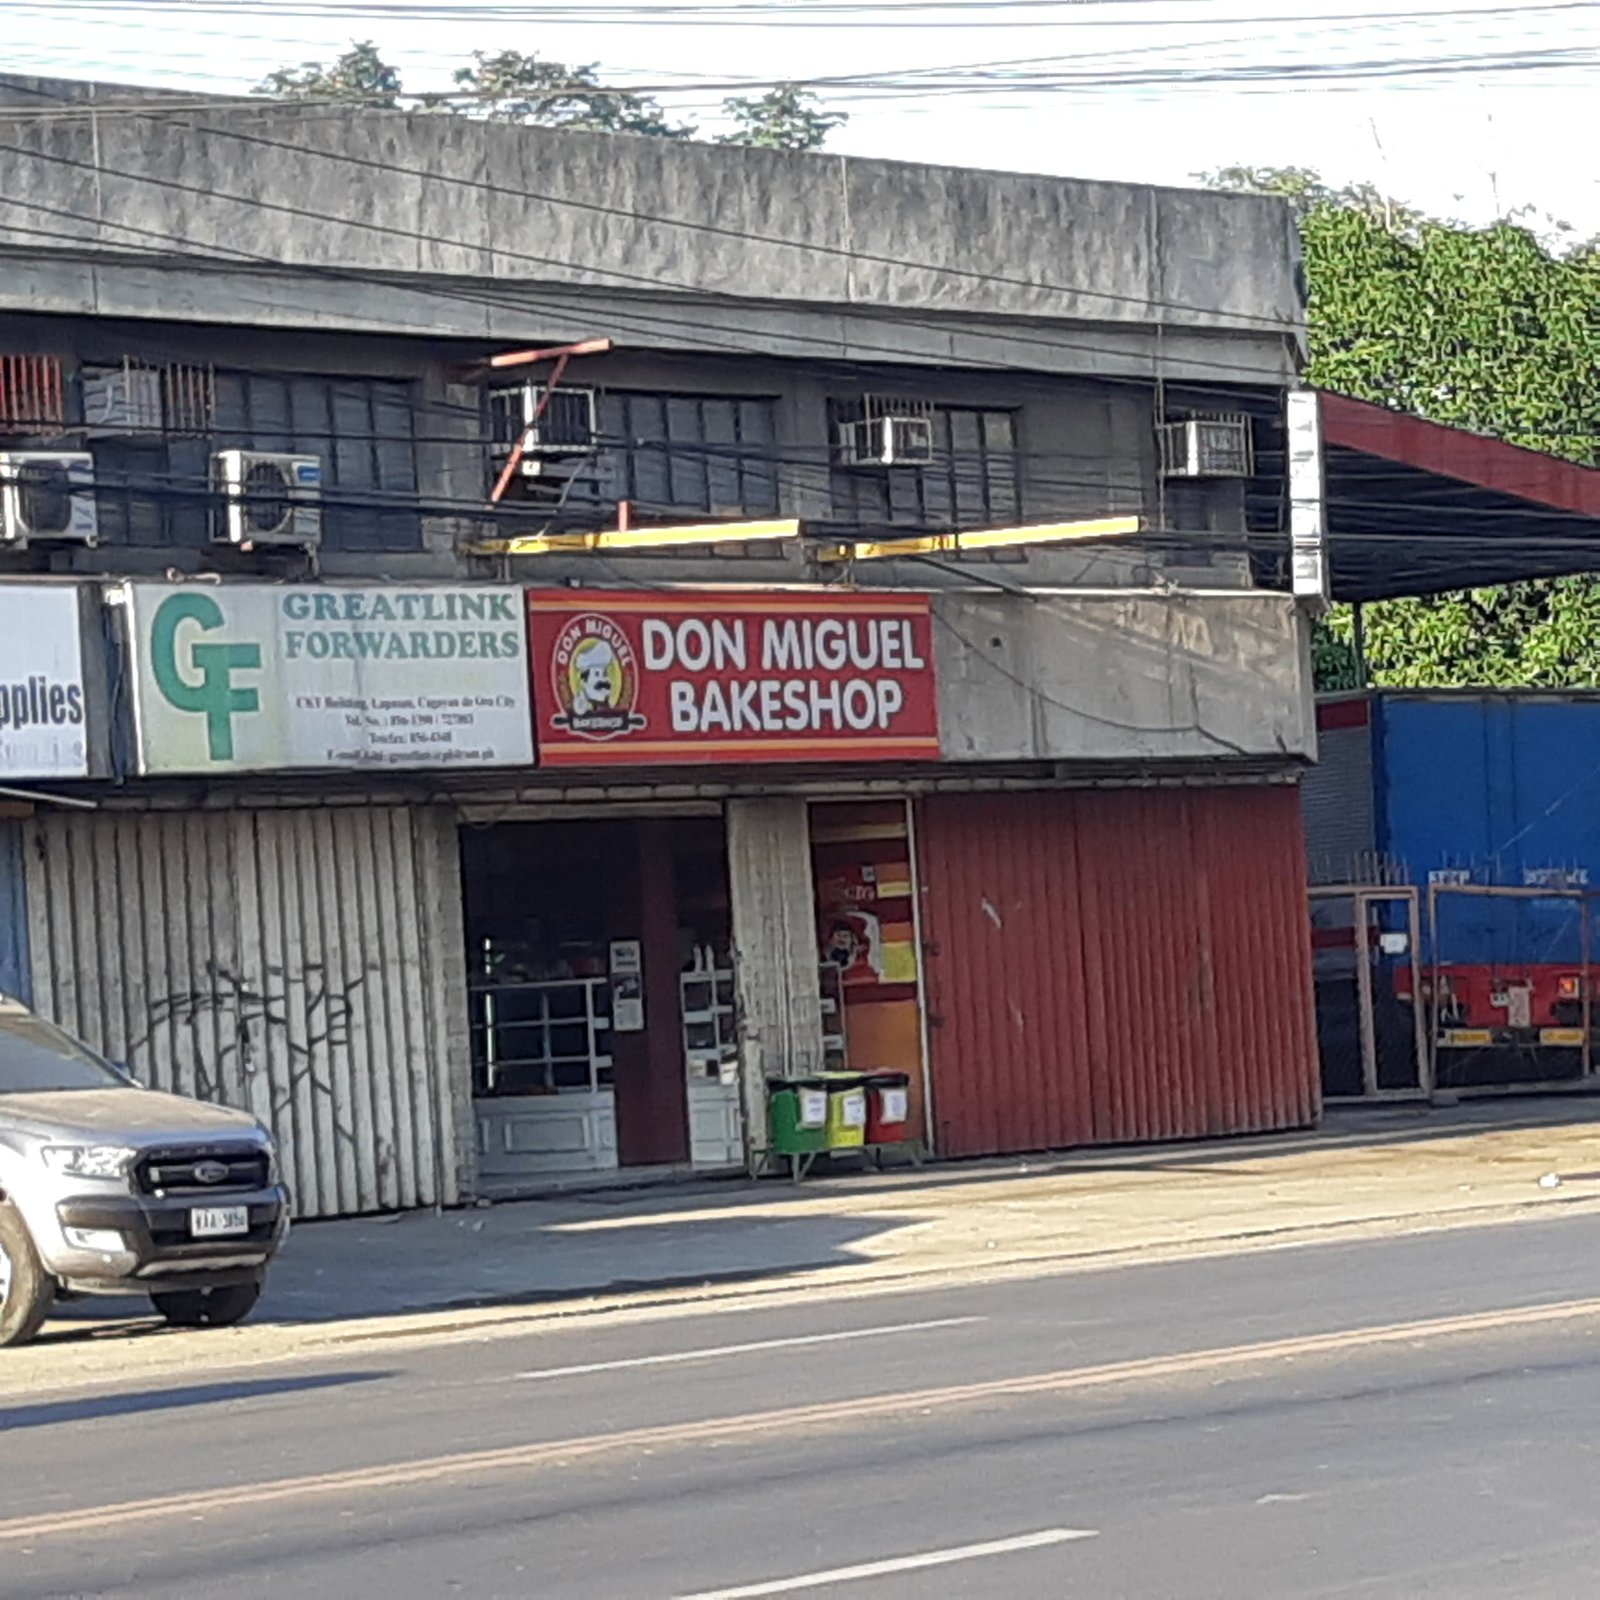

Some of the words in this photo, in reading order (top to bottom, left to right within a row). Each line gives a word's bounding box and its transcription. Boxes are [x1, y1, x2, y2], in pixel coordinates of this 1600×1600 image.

[283, 593, 518, 620] GREATLINK
[285, 630, 519, 658] FORWARDERS
[557, 623, 582, 665] DON
[585, 618, 633, 667] MIGUEL
[641, 618, 747, 672] DON
[761, 618, 925, 671] MIGUEL
[669, 678, 903, 732] BAKESHOP
